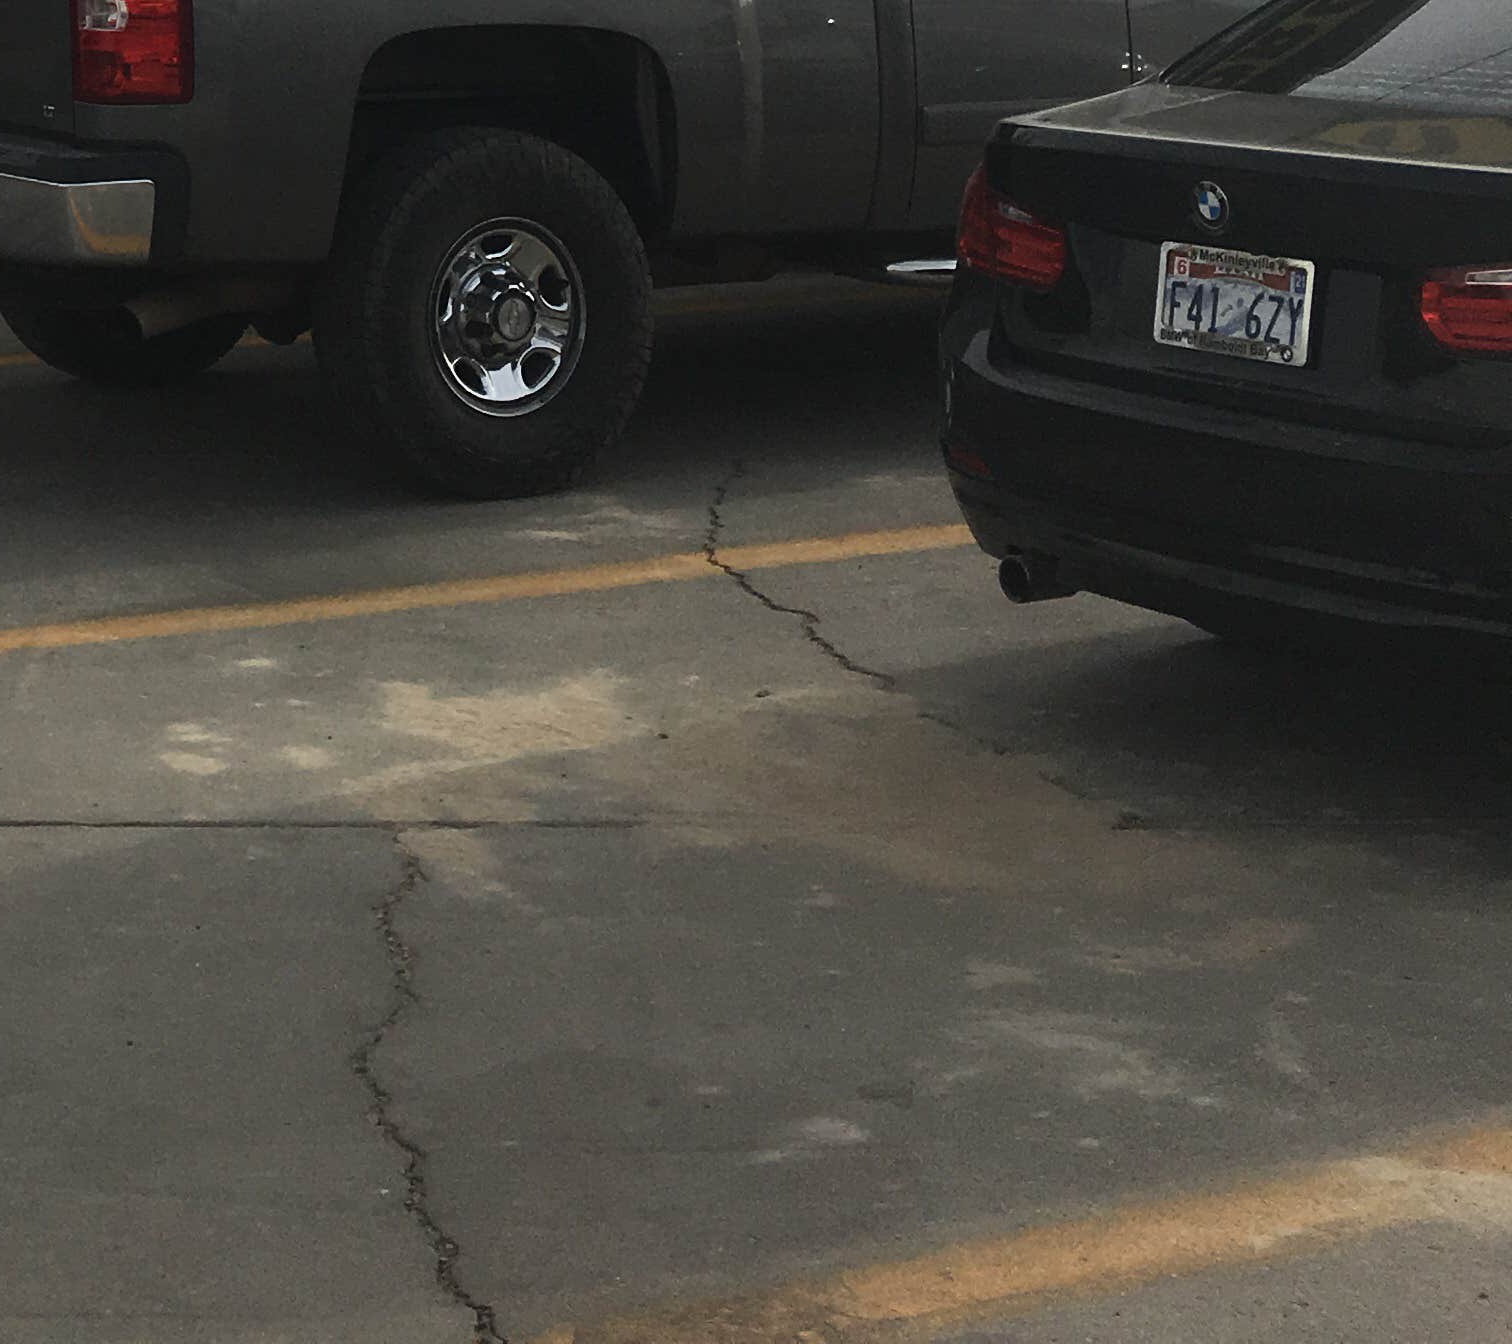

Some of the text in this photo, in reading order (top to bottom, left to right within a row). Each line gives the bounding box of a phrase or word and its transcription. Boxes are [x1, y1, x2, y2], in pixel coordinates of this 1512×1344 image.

[1176, 259, 1187, 275] 6
[1169, 280, 1304, 346] F41 6ZY
